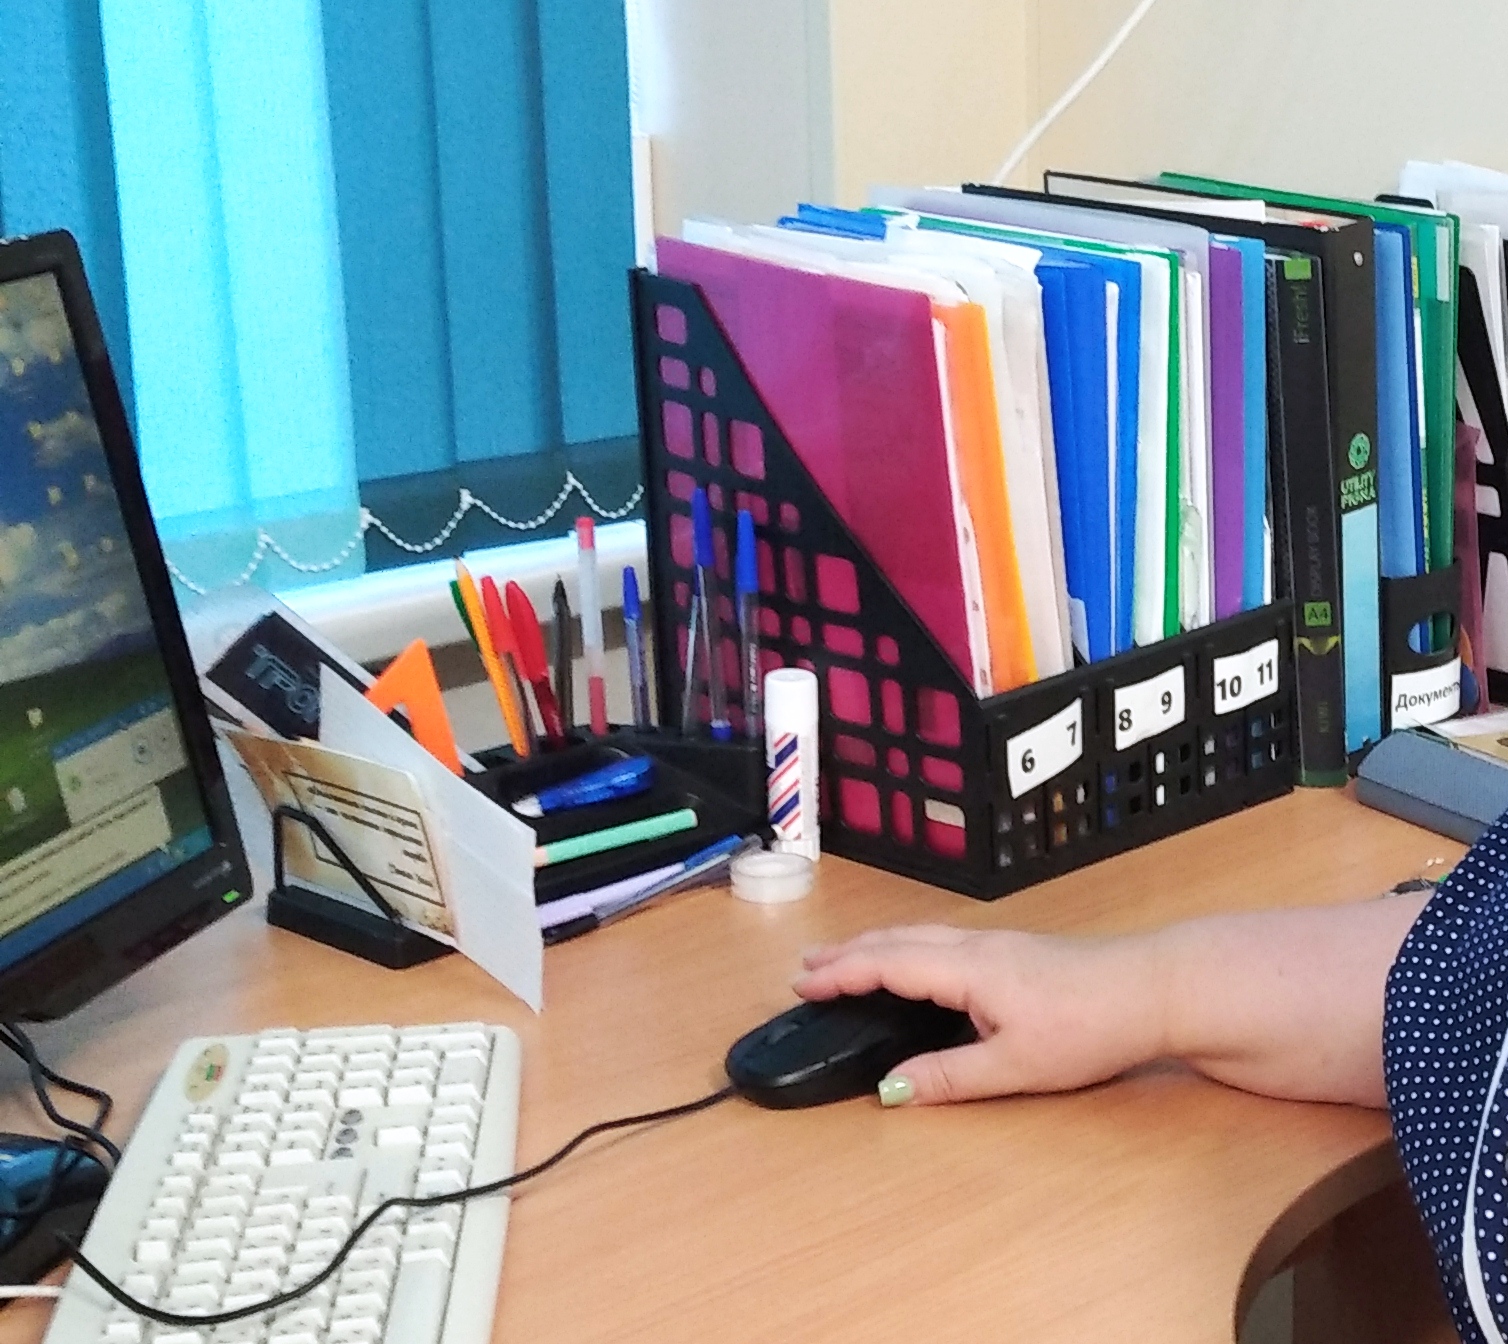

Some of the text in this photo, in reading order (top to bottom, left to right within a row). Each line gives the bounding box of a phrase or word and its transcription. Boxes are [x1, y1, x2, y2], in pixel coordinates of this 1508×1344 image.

[1307, 607, 1329, 621] A4
[1216, 659, 1274, 701] 10 11
[1118, 691, 1173, 732] 8 9
[1021, 721, 1078, 774] 6 7
